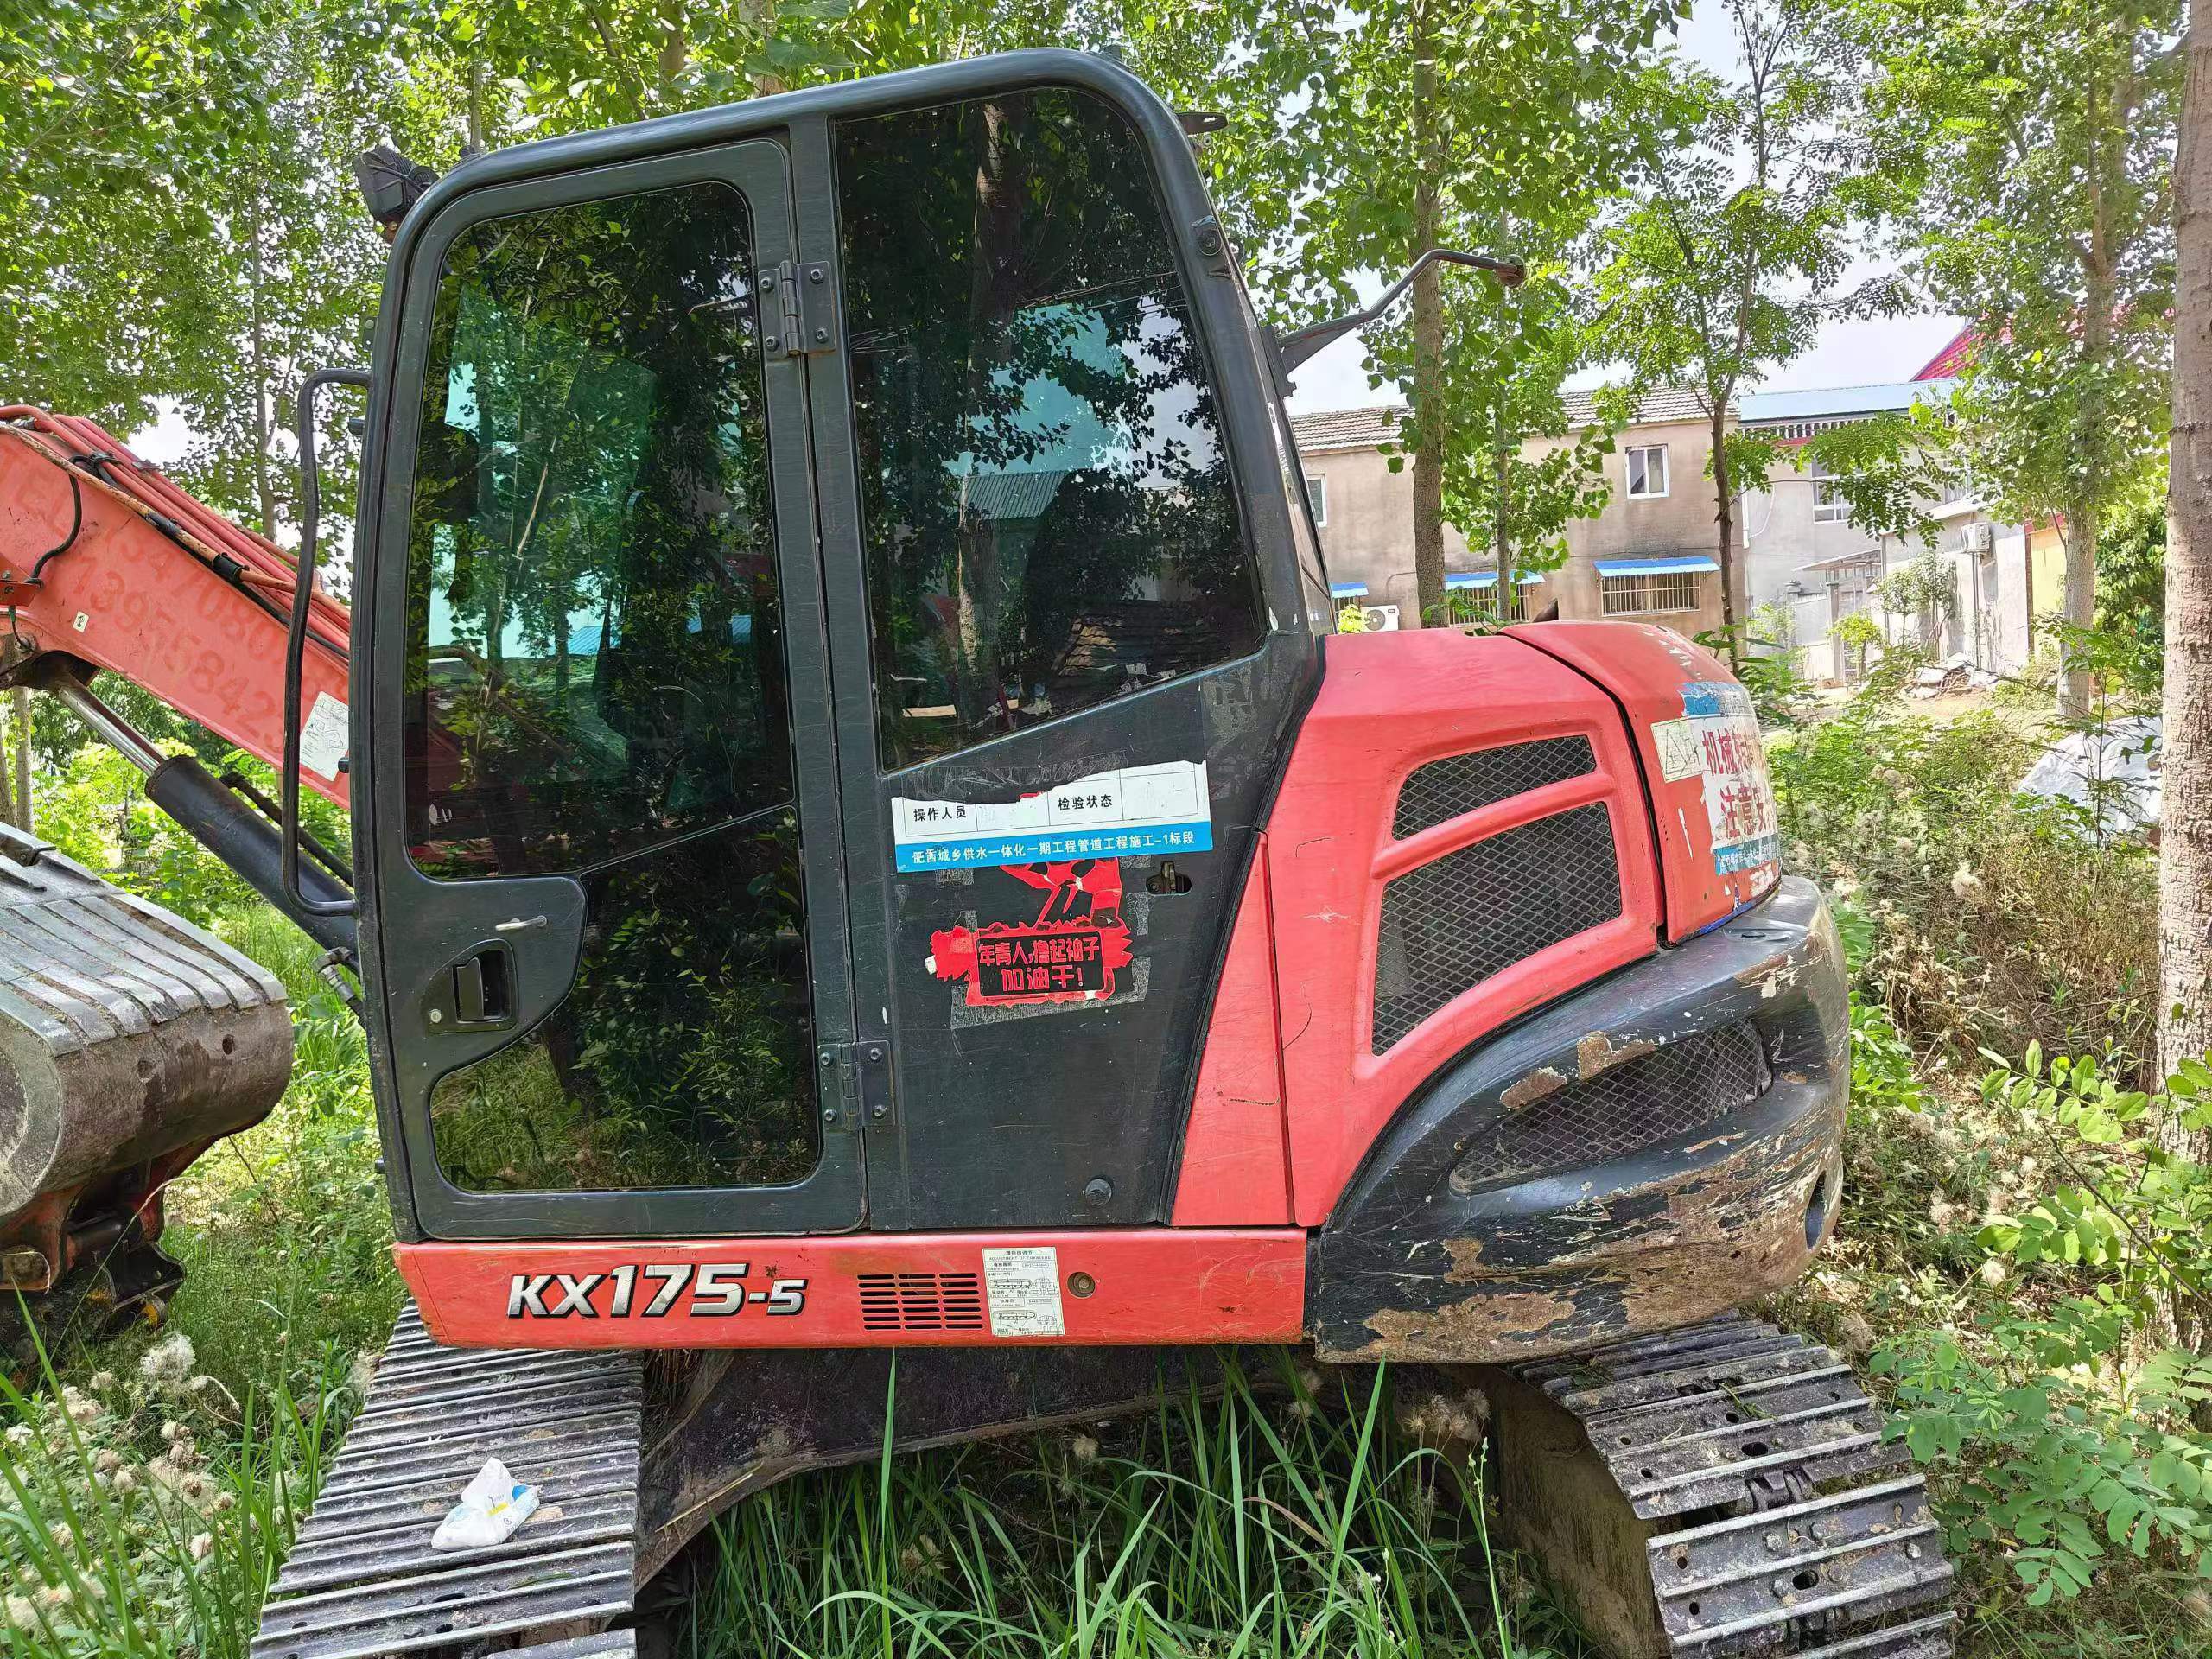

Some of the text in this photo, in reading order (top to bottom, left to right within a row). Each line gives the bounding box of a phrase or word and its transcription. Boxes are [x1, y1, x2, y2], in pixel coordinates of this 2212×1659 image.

[1058, 793, 1114, 811] 检验状态
[913, 804, 968, 822] 操作人员
[508, 1262, 809, 1318] KX175-5
